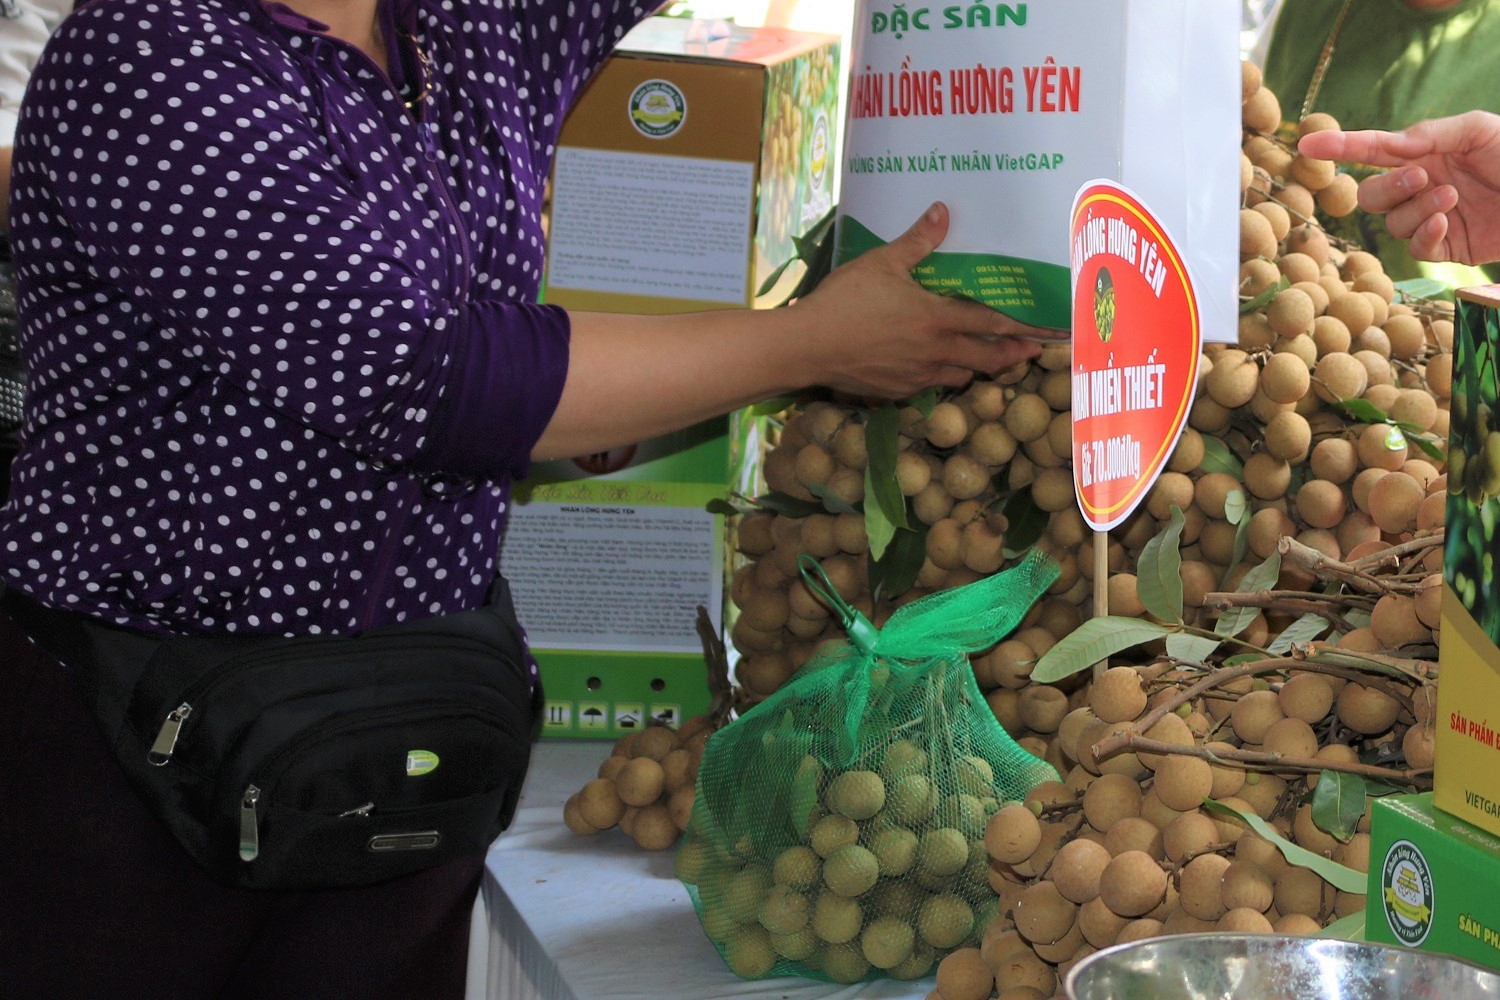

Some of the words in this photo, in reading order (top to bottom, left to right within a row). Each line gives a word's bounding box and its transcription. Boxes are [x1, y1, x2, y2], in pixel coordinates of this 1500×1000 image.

[871, 2, 930, 39] ĐẶC
[888, 55, 943, 118] LỒNG
[950, 62, 1014, 114] HƯNG
[1022, 55, 1080, 112] YÊN
[849, 155, 874, 174] VÙNG
[876, 149, 902, 173] SẢN
[907, 148, 947, 172] XUẤT
[951, 150, 991, 172] NHÃN
[995, 153, 1064, 171] VietGAP
[1083, 207, 1106, 262] LỒNG
[1108, 216, 1138, 266] HƯNG
[1140, 236, 1167, 298] YÊN
[1091, 352, 1122, 416] MIỀN
[1124, 348, 1166, 411] THIẾT
[1450, 710, 1467, 735] SẢN
[1469, 719, 1494, 747] PHẨM
[1458, 912, 1480, 939] SẢN
